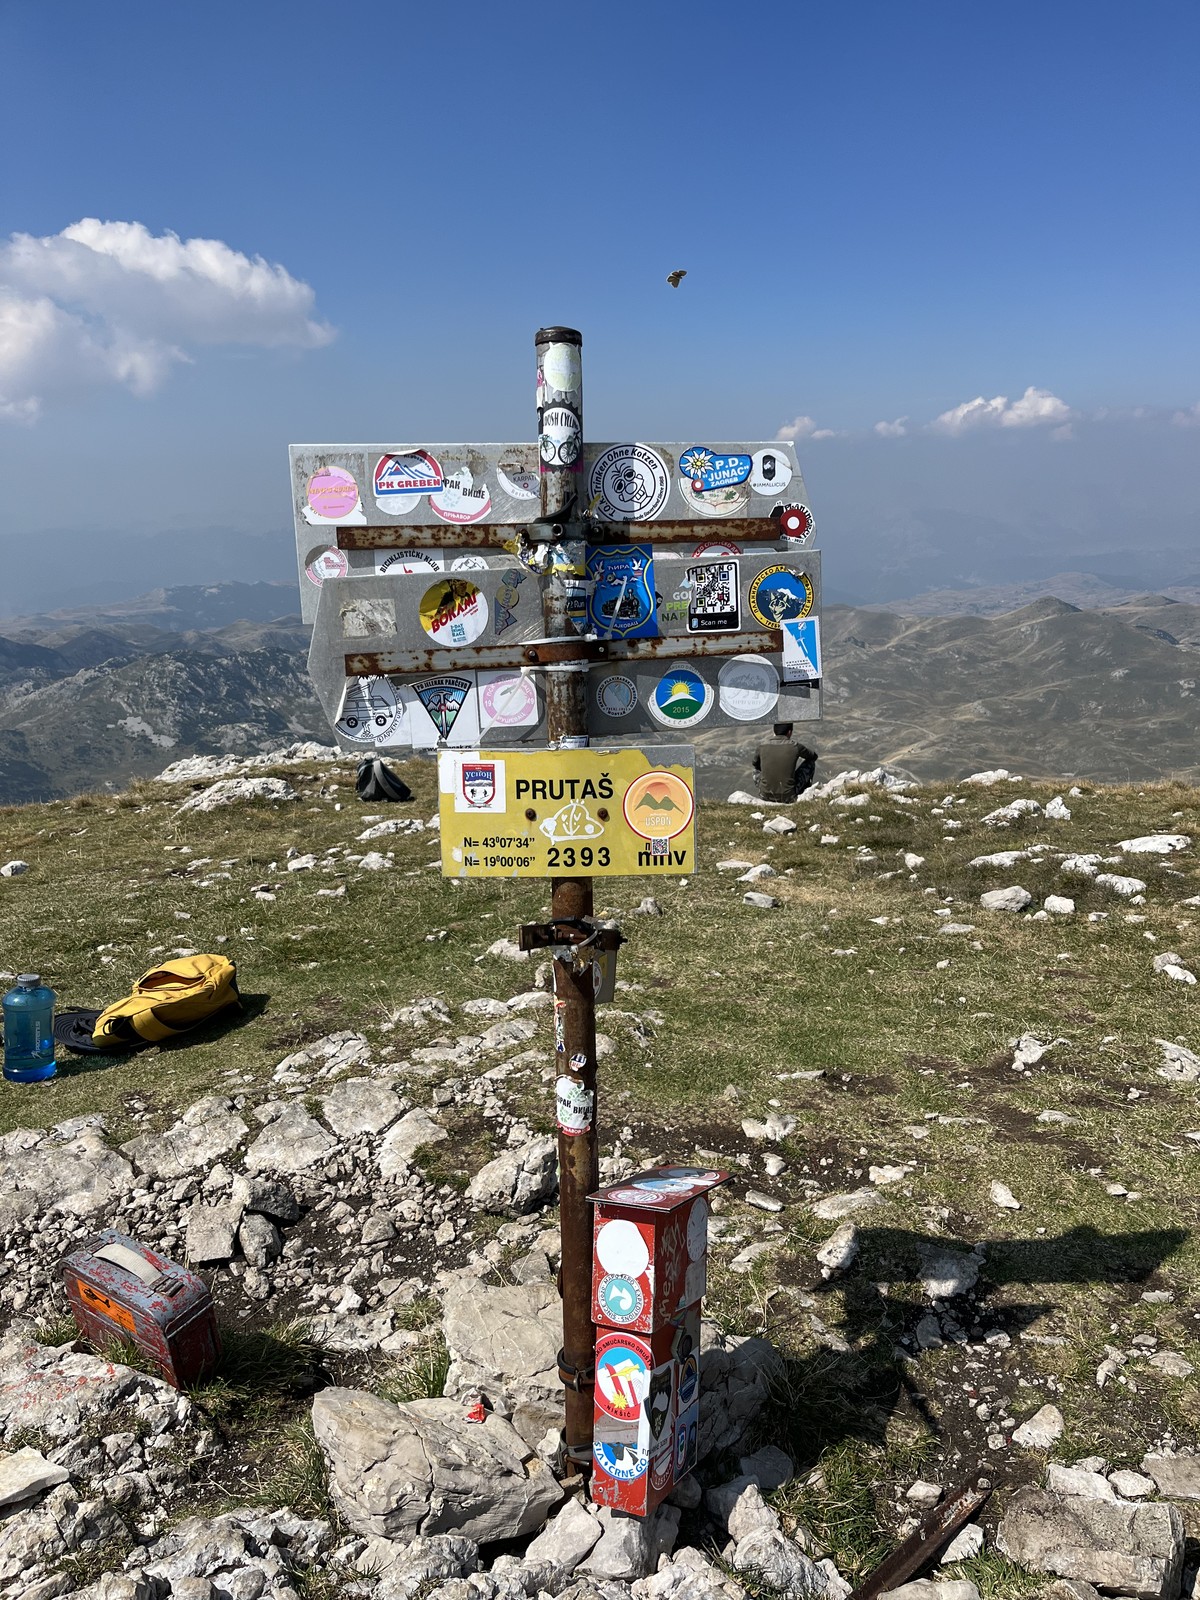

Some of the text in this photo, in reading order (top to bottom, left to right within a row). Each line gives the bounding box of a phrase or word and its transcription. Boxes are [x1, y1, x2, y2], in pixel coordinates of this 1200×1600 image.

[715, 457, 743, 470] P.D.
[593, 461, 609, 493] Trinken
[607, 449, 630, 462] Ohne
[631, 447, 658, 470] Kotzen
[702, 465, 750, 482] "JUNAC"
[378, 478, 441, 489] PK GREBEN
[442, 478, 461, 490] РАК
[710, 477, 739, 487] ZAGREB
[462, 487, 486, 500] ВИШЕ
[443, 511, 471, 520] ПРЊАВОР
[379, 549, 440, 574] BICIKLISTIČKI KLUB
[691, 564, 733, 575] HIKING
[752, 567, 774, 614] ПЛАНИНАРСКО
[665, 600, 689, 611] PRE
[691, 605, 735, 614] TRIPS
[661, 612, 678, 622] NA
[613, 620, 639, 628] АЈКОВАЦ
[445, 679, 468, 690] PANČEVO
[485, 699, 492, 707] 19
[672, 706, 690, 714] 2015
[465, 771, 492, 780] УСПОН
[516, 773, 614, 800] PRUTAŠ
[645, 816, 671, 826] USPON
[463, 837, 479, 848] N=
[464, 857, 480, 867] N=
[547, 847, 611, 868] 2393
[621, 1288, 643, 1322] EXPEDITIONS
[602, 1339, 636, 1351] SMUČARSKO
[606, 1404, 632, 1418] NIKŠIĆ
[608, 1457, 649, 1478] CRNE GO
